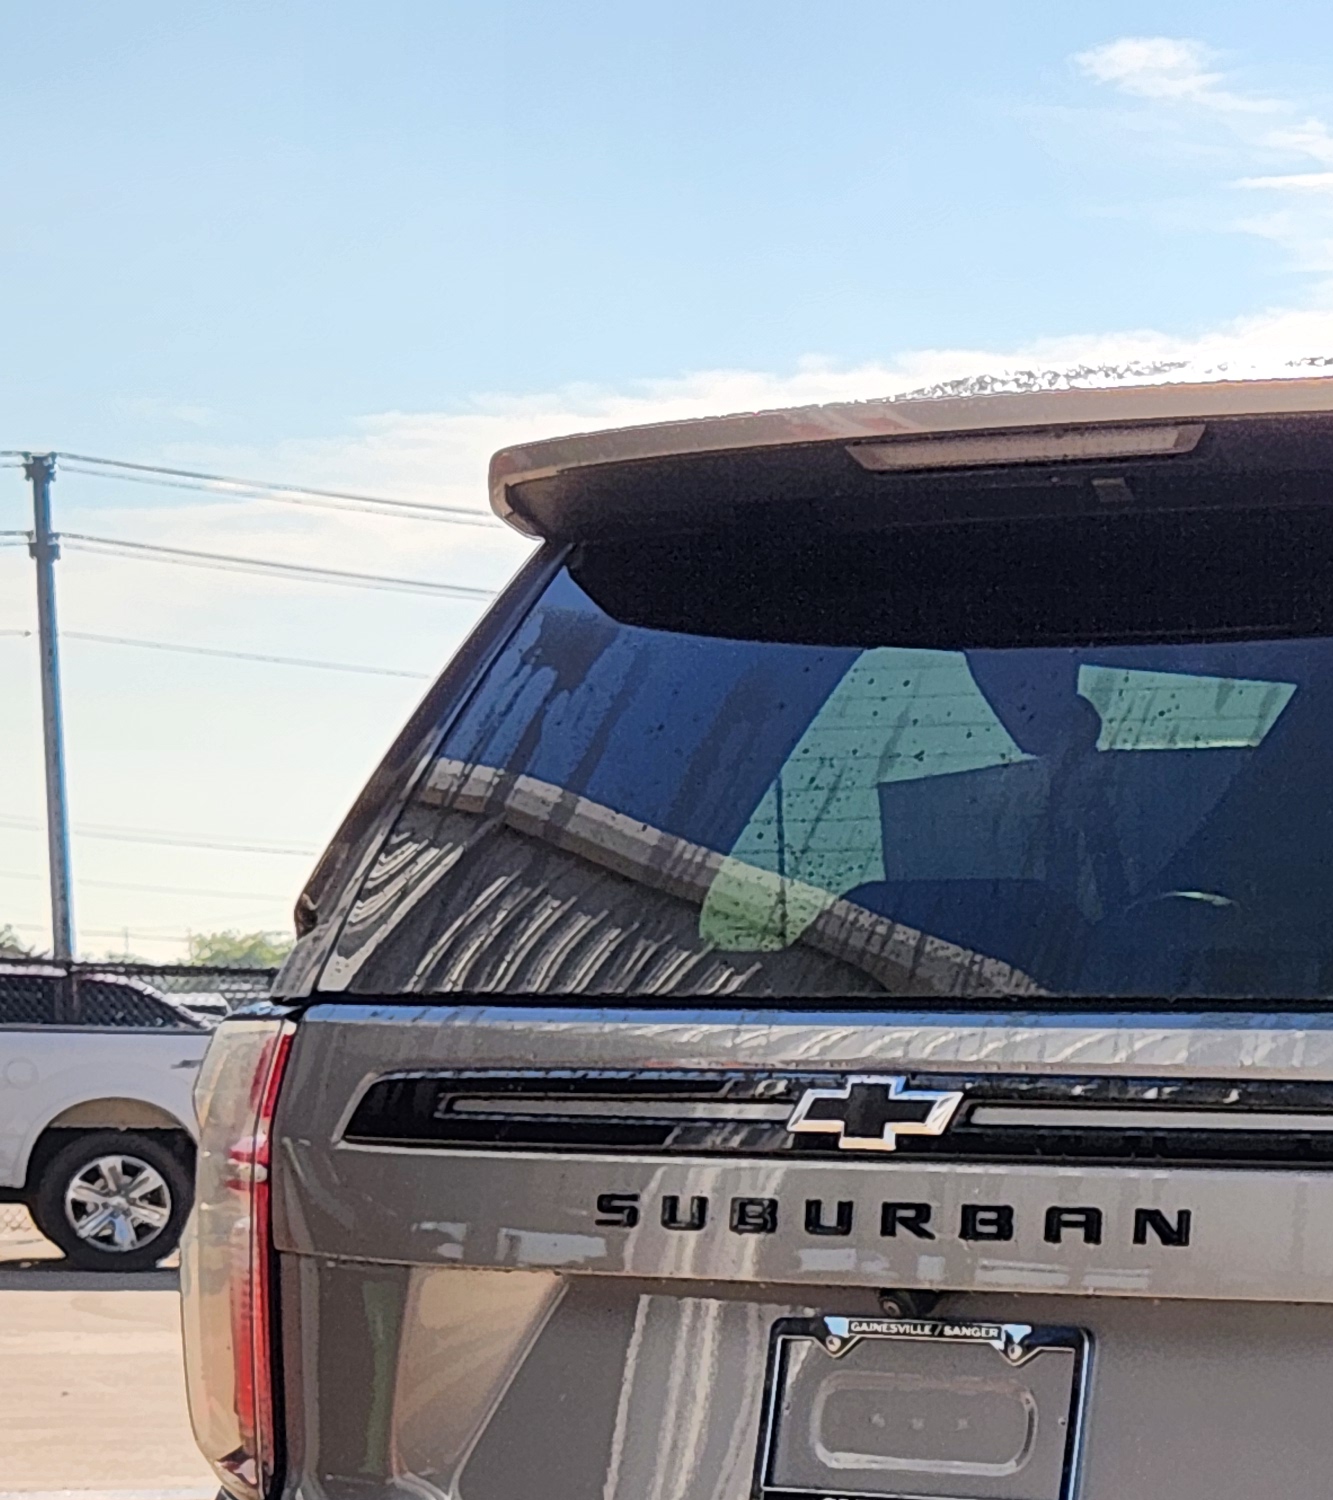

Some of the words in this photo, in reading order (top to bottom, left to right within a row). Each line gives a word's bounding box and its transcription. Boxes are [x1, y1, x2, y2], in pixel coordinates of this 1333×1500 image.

[595, 1193, 1191, 1247] SUBURBAN
[850, 1321, 933, 1336] GAINESVILLE
[943, 1325, 999, 1338] SANGER
